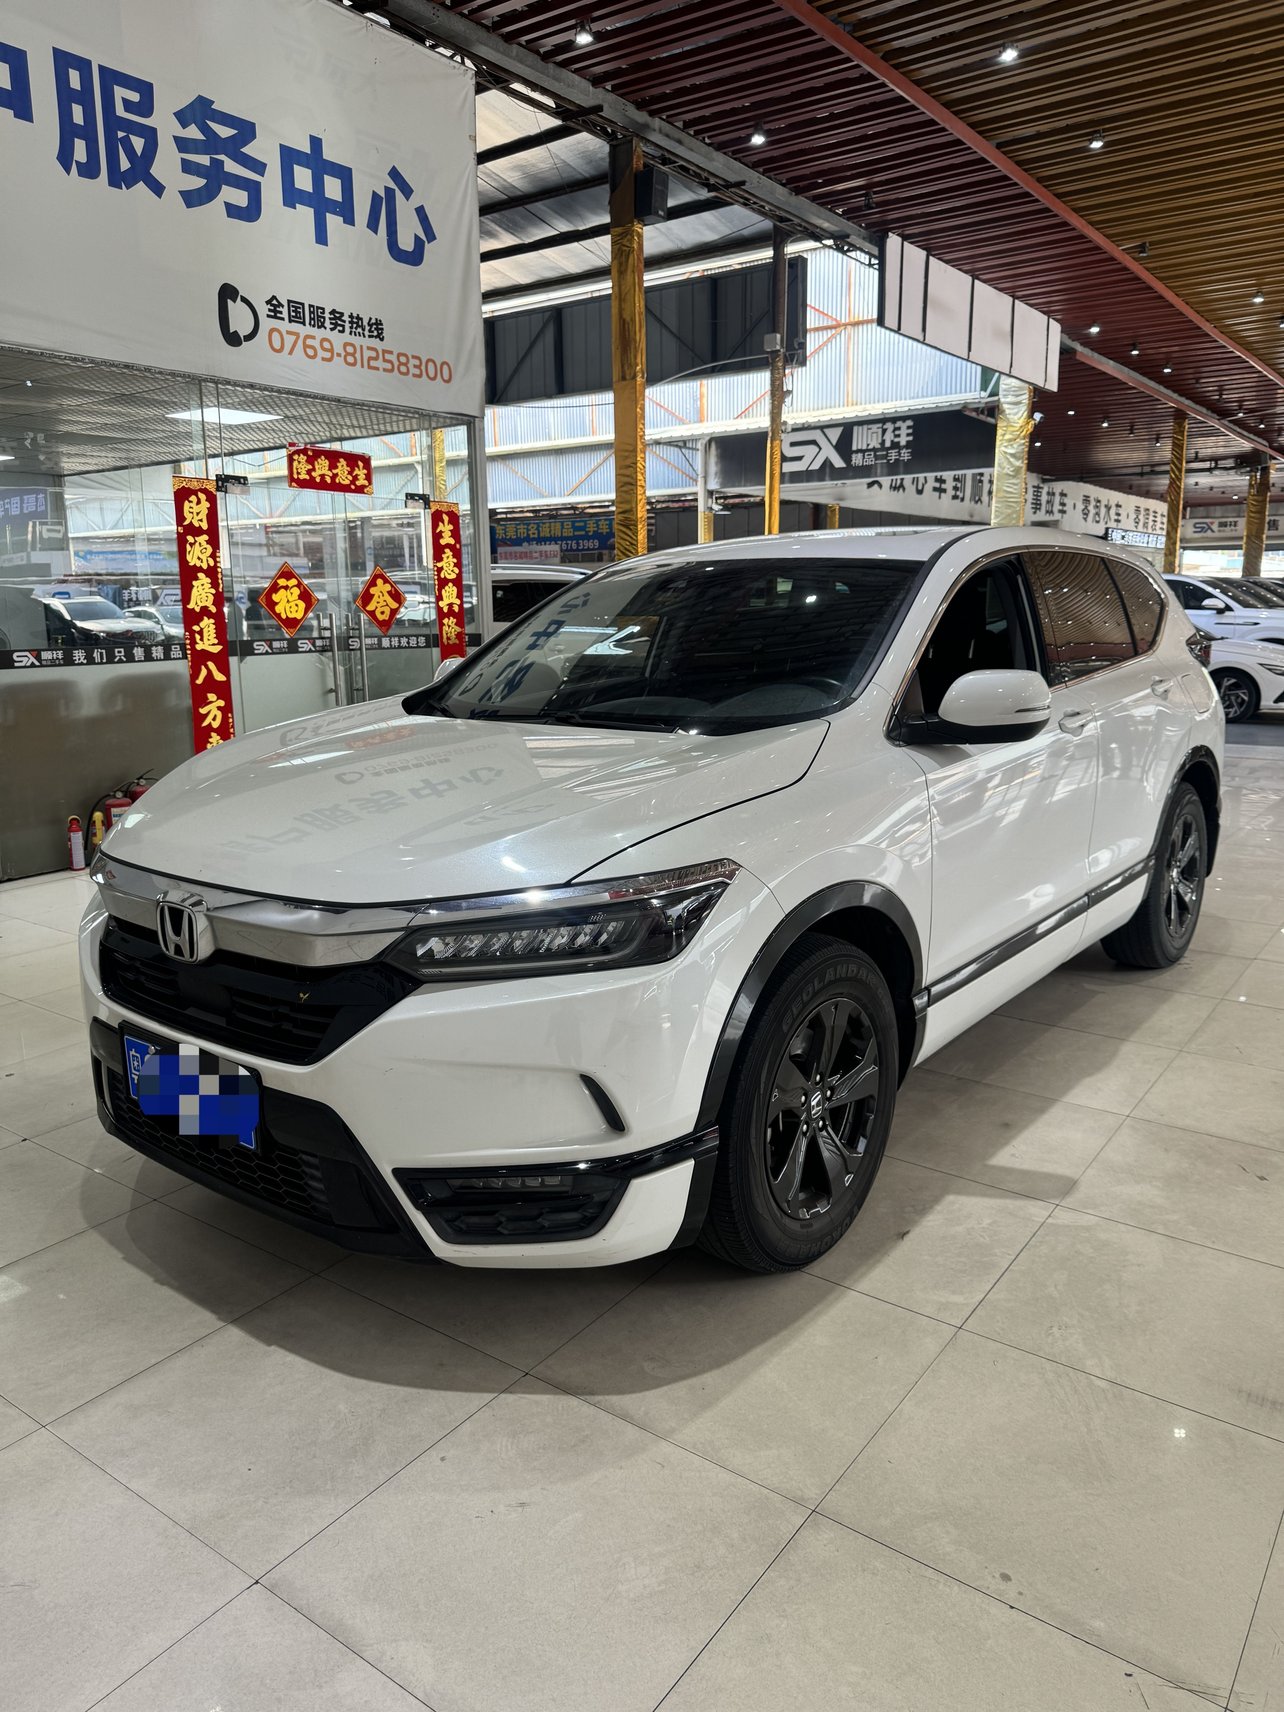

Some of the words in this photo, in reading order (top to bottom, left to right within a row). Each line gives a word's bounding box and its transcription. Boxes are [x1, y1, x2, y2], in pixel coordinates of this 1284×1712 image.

[265, 295, 386, 342] 全国服务热线
[267, 326, 453, 384] 0769-81258300
[852, 418, 914, 451] 顺祥
[782, 426, 847, 473] SX
[850, 448, 913, 468] 精品二手车
[271, 577, 306, 620] 福
[41, 650, 64, 660] 顺祥
[381, 636, 427, 648] 顺祥欢迎您
[12, 651, 41, 667] SX
[72, 646, 184, 665] 我们只售精品
